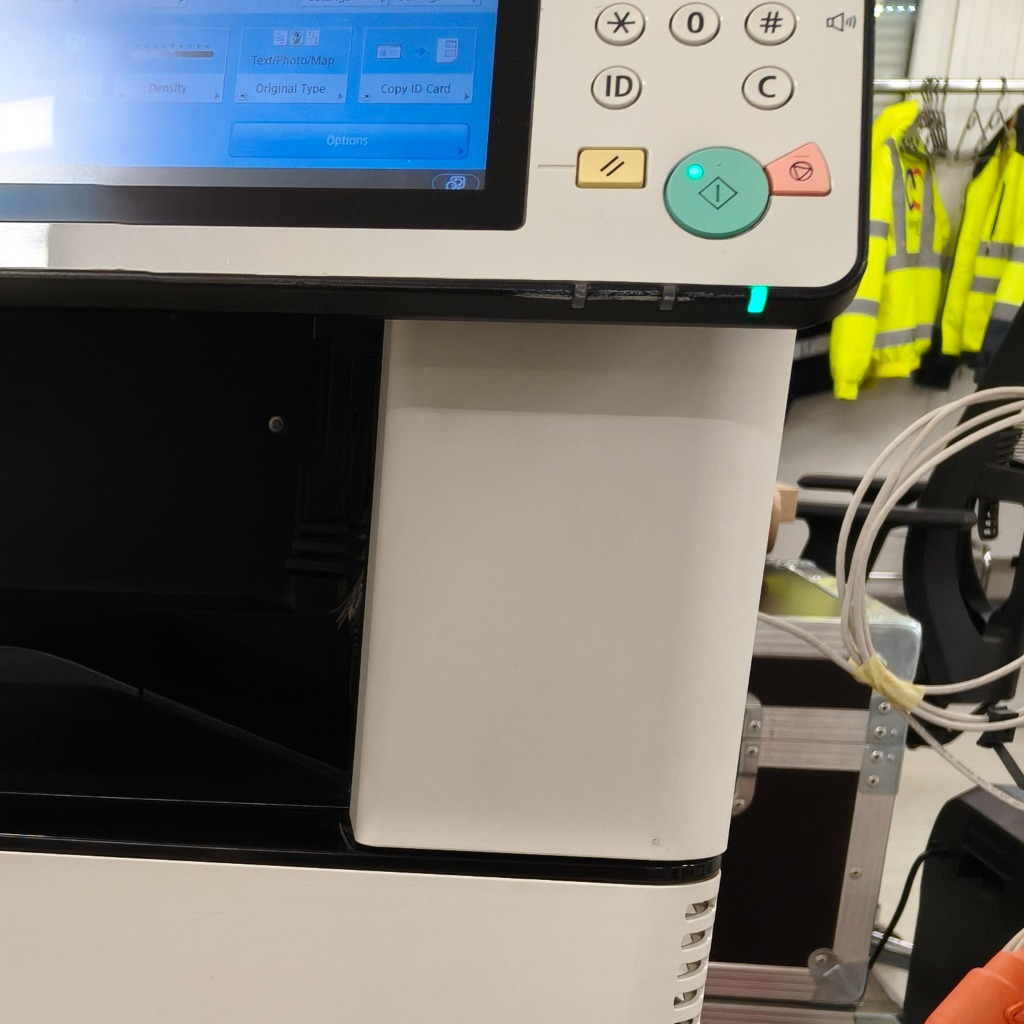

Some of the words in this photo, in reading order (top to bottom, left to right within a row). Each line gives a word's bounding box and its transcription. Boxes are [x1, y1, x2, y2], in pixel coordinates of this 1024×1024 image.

[687, 11, 705, 34] 0
[252, 55, 334, 67] Text/Photo/Map
[149, 83, 187, 95] Density
[256, 83, 297, 95] Original
[301, 83, 326, 95] Type
[380, 83, 407, 95] Copy
[411, 84, 423, 94] ID
[426, 83, 451, 94] Card
[605, 75, 633, 97] ID
[758, 75, 777, 98] C
[326, 135, 368, 147] Options
